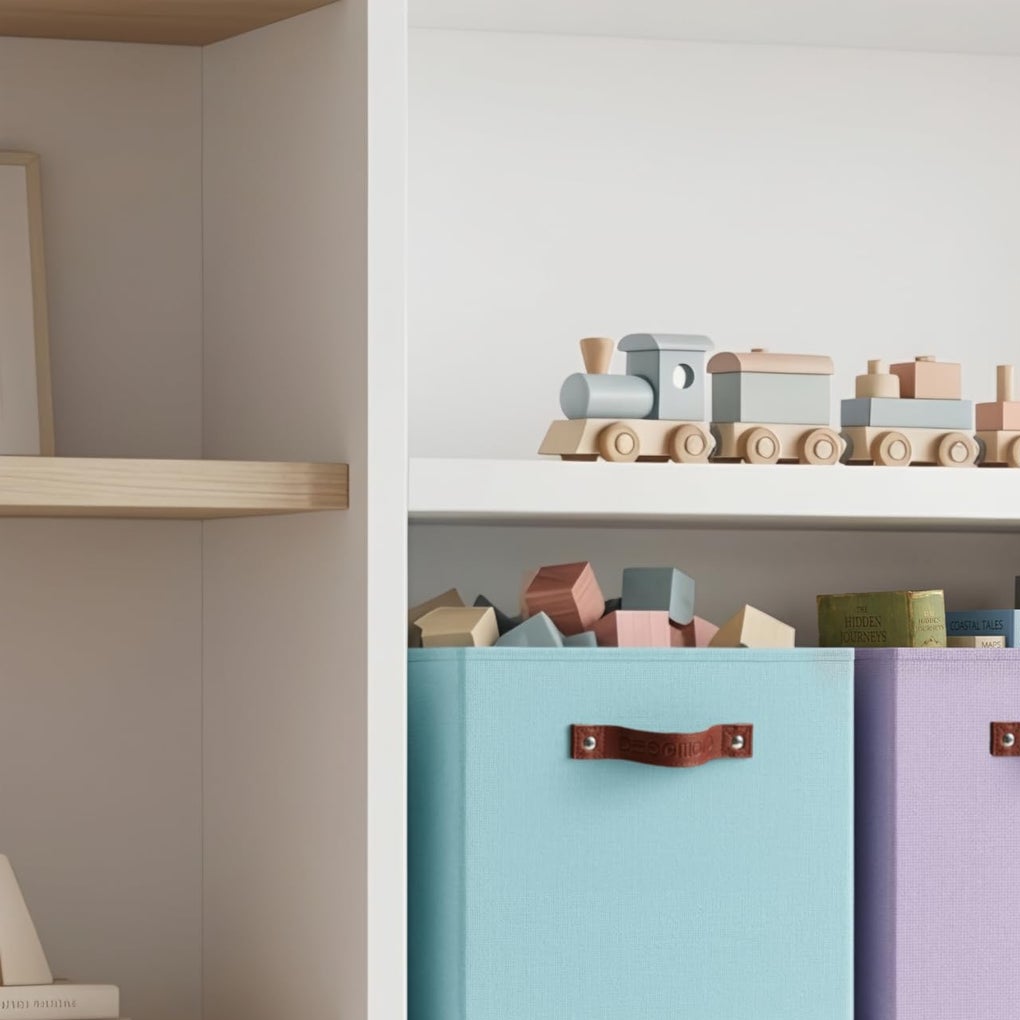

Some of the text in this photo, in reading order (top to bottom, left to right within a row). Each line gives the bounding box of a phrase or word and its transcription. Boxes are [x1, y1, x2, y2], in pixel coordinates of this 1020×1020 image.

[845, 616, 882, 628] HIDDEN
[950, 619, 1004, 631] COASTAL TALES
[840, 630, 887, 643] JOURNEYS
